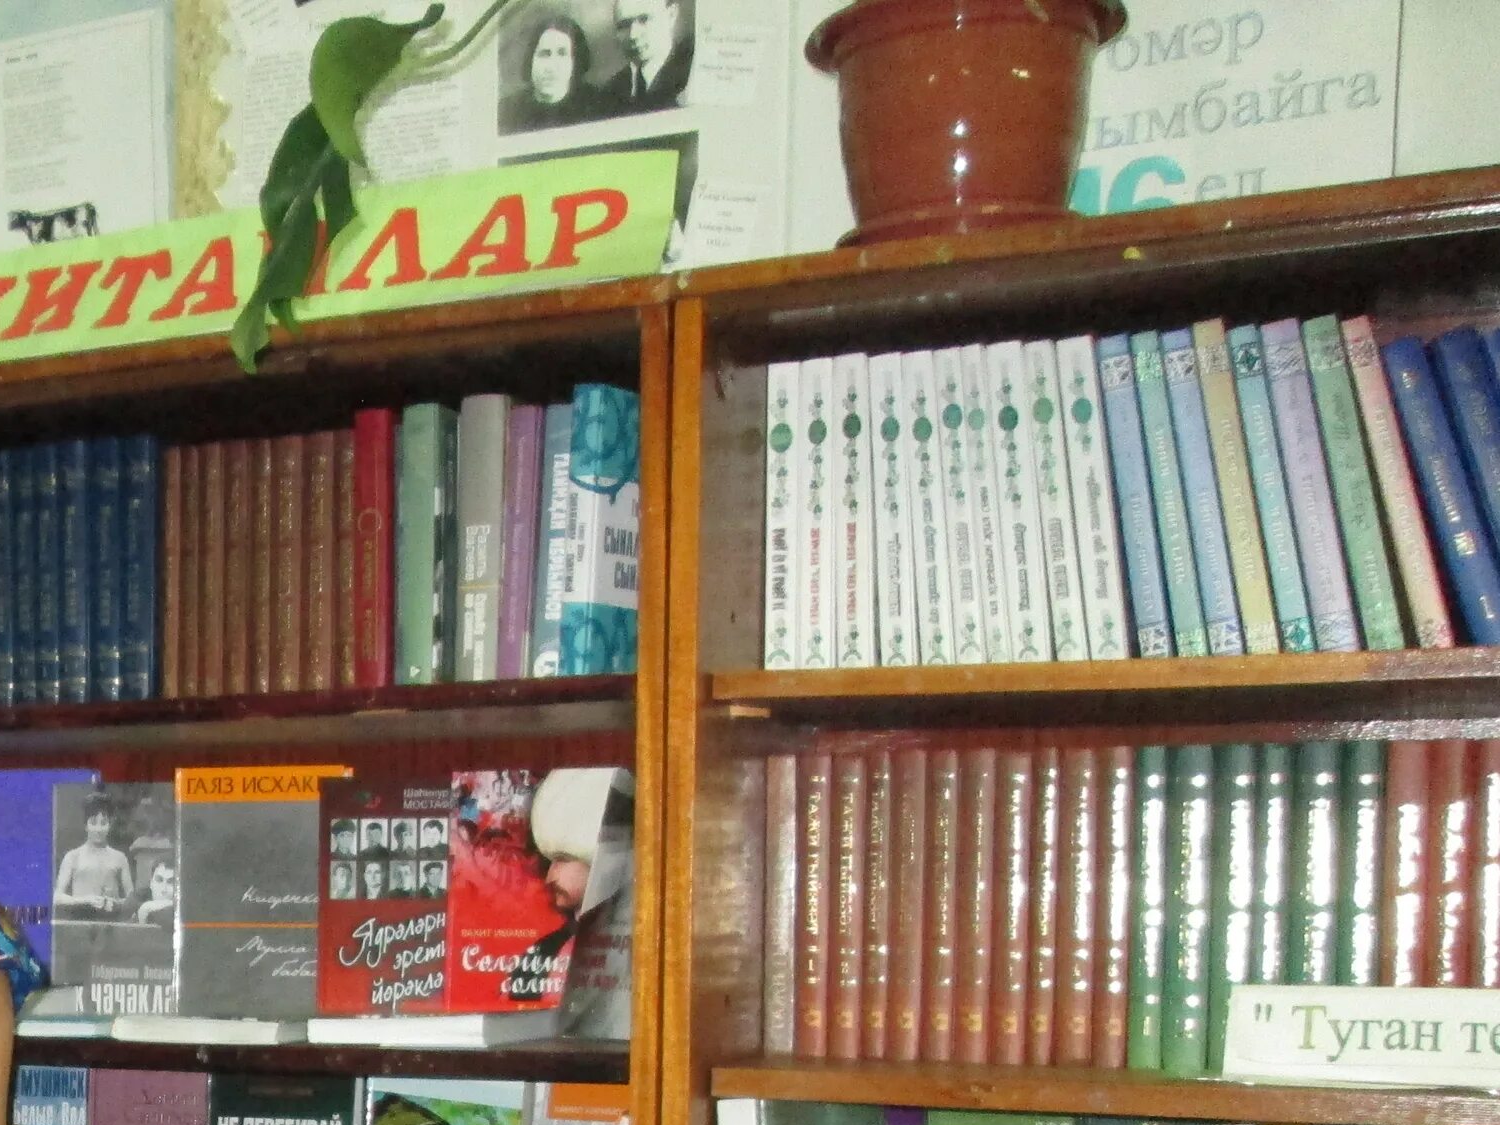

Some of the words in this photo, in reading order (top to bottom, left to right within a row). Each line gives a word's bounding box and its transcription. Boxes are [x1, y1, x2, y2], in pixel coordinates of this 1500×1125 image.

[1106, 10, 1263, 70] омәр
[1093, 68, 1381, 150] ымбайга
[187, 777, 234, 795] ГАЯЗ
[242, 774, 322, 793] ИСХАК
[339, 911, 446, 968] Ядрәләрн
[91, 983, 175, 1015] ЧӘЧӘКЛӘ
[1291, 1004, 1443, 1062] Туган
[1460, 1019, 1500, 1054] те
